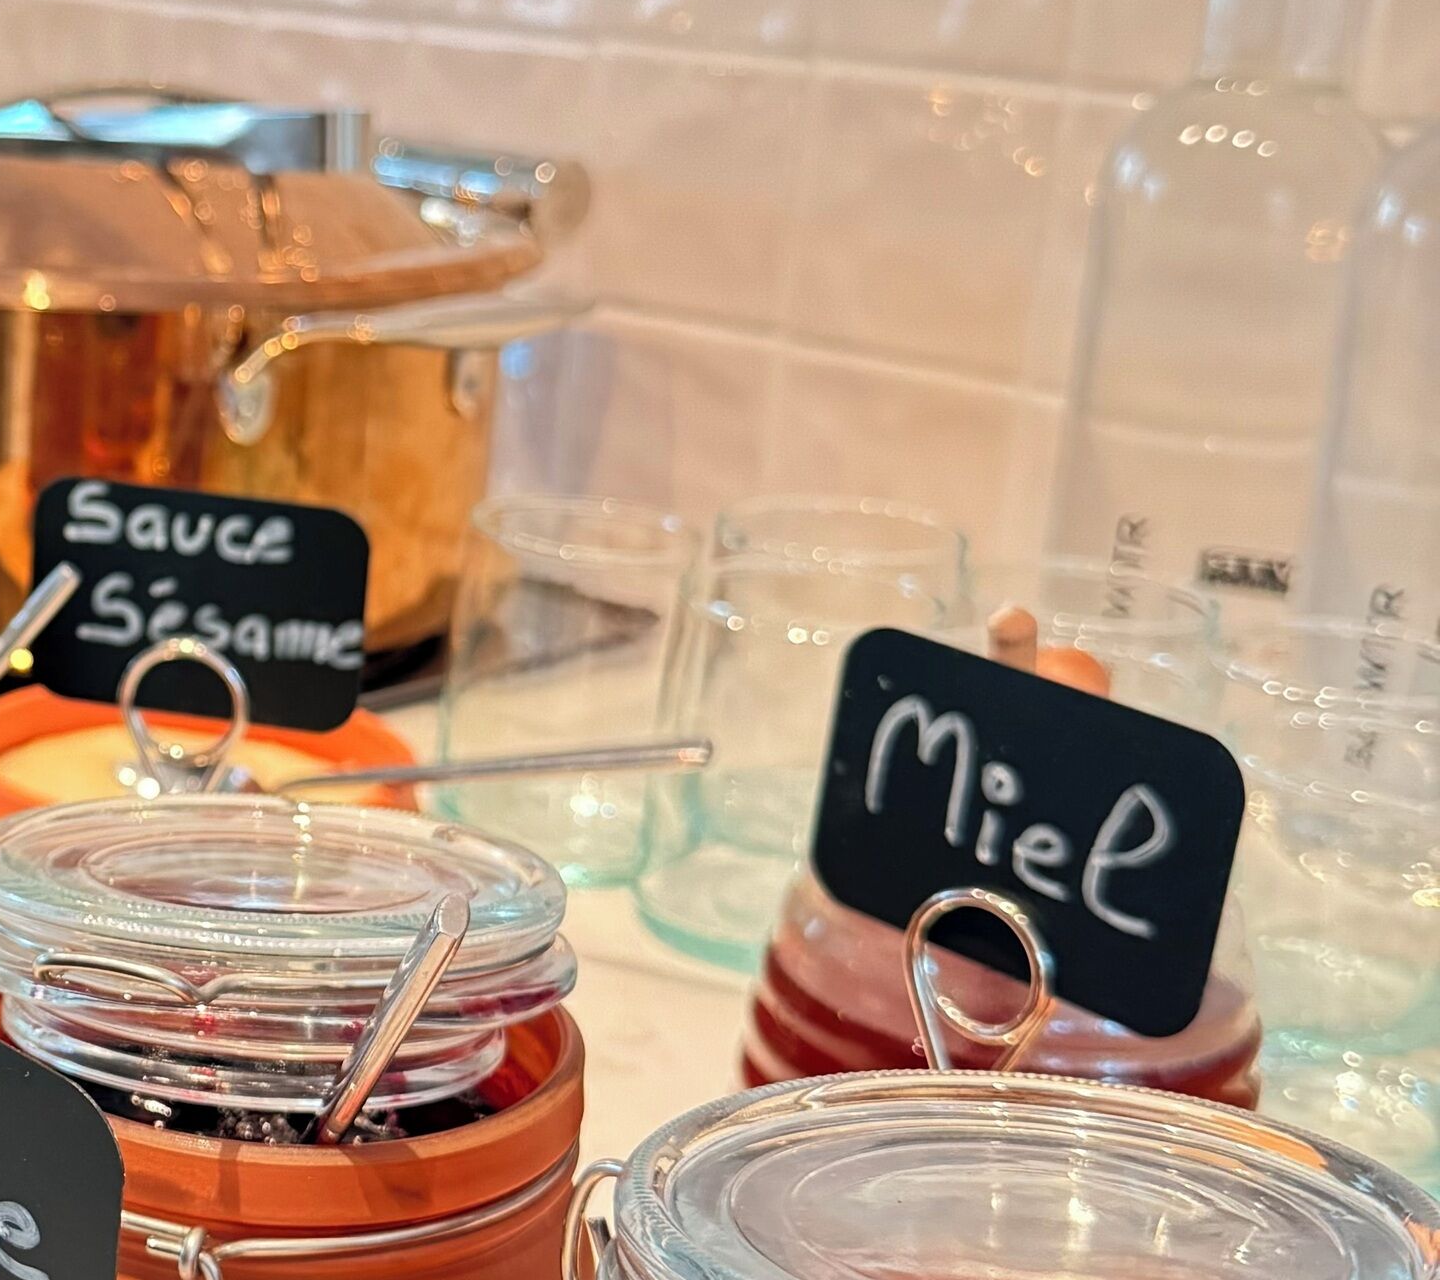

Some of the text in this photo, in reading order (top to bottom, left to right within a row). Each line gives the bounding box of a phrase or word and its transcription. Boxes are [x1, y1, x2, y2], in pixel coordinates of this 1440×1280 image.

[63, 479, 294, 565] Sauce
[75, 571, 365, 671] Sésame
[865, 694, 1176, 940] Miel
